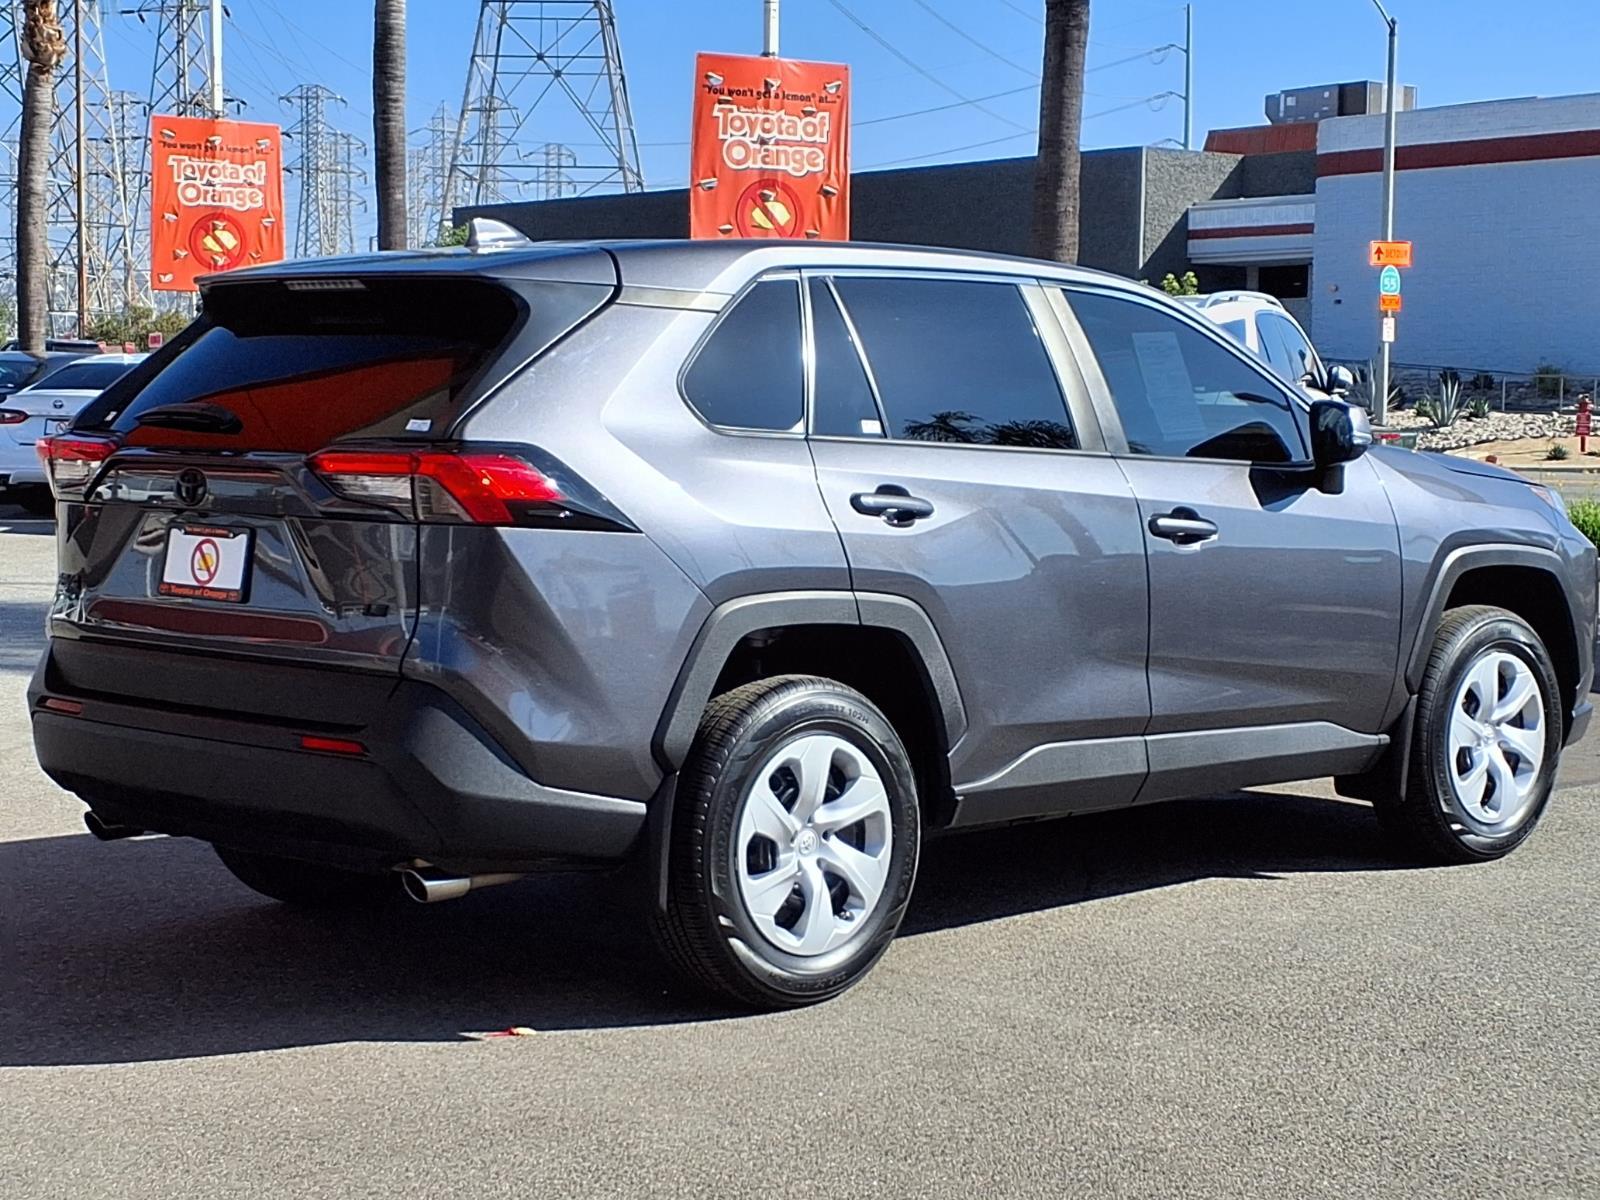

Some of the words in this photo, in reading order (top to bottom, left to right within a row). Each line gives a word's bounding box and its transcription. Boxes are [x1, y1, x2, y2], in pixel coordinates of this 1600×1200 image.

[727, 87, 754, 97] won't
[756, 90, 771, 100] get
[713, 104, 800, 139] Toyota
[800, 112, 830, 143] of
[169, 156, 241, 182] Toyota
[241, 161, 266, 185] of
[722, 137, 825, 176] Orange
[178, 180, 263, 211] Orange
[1383, 277, 1397, 291] 55
[848, 708, 869, 724] 102H
